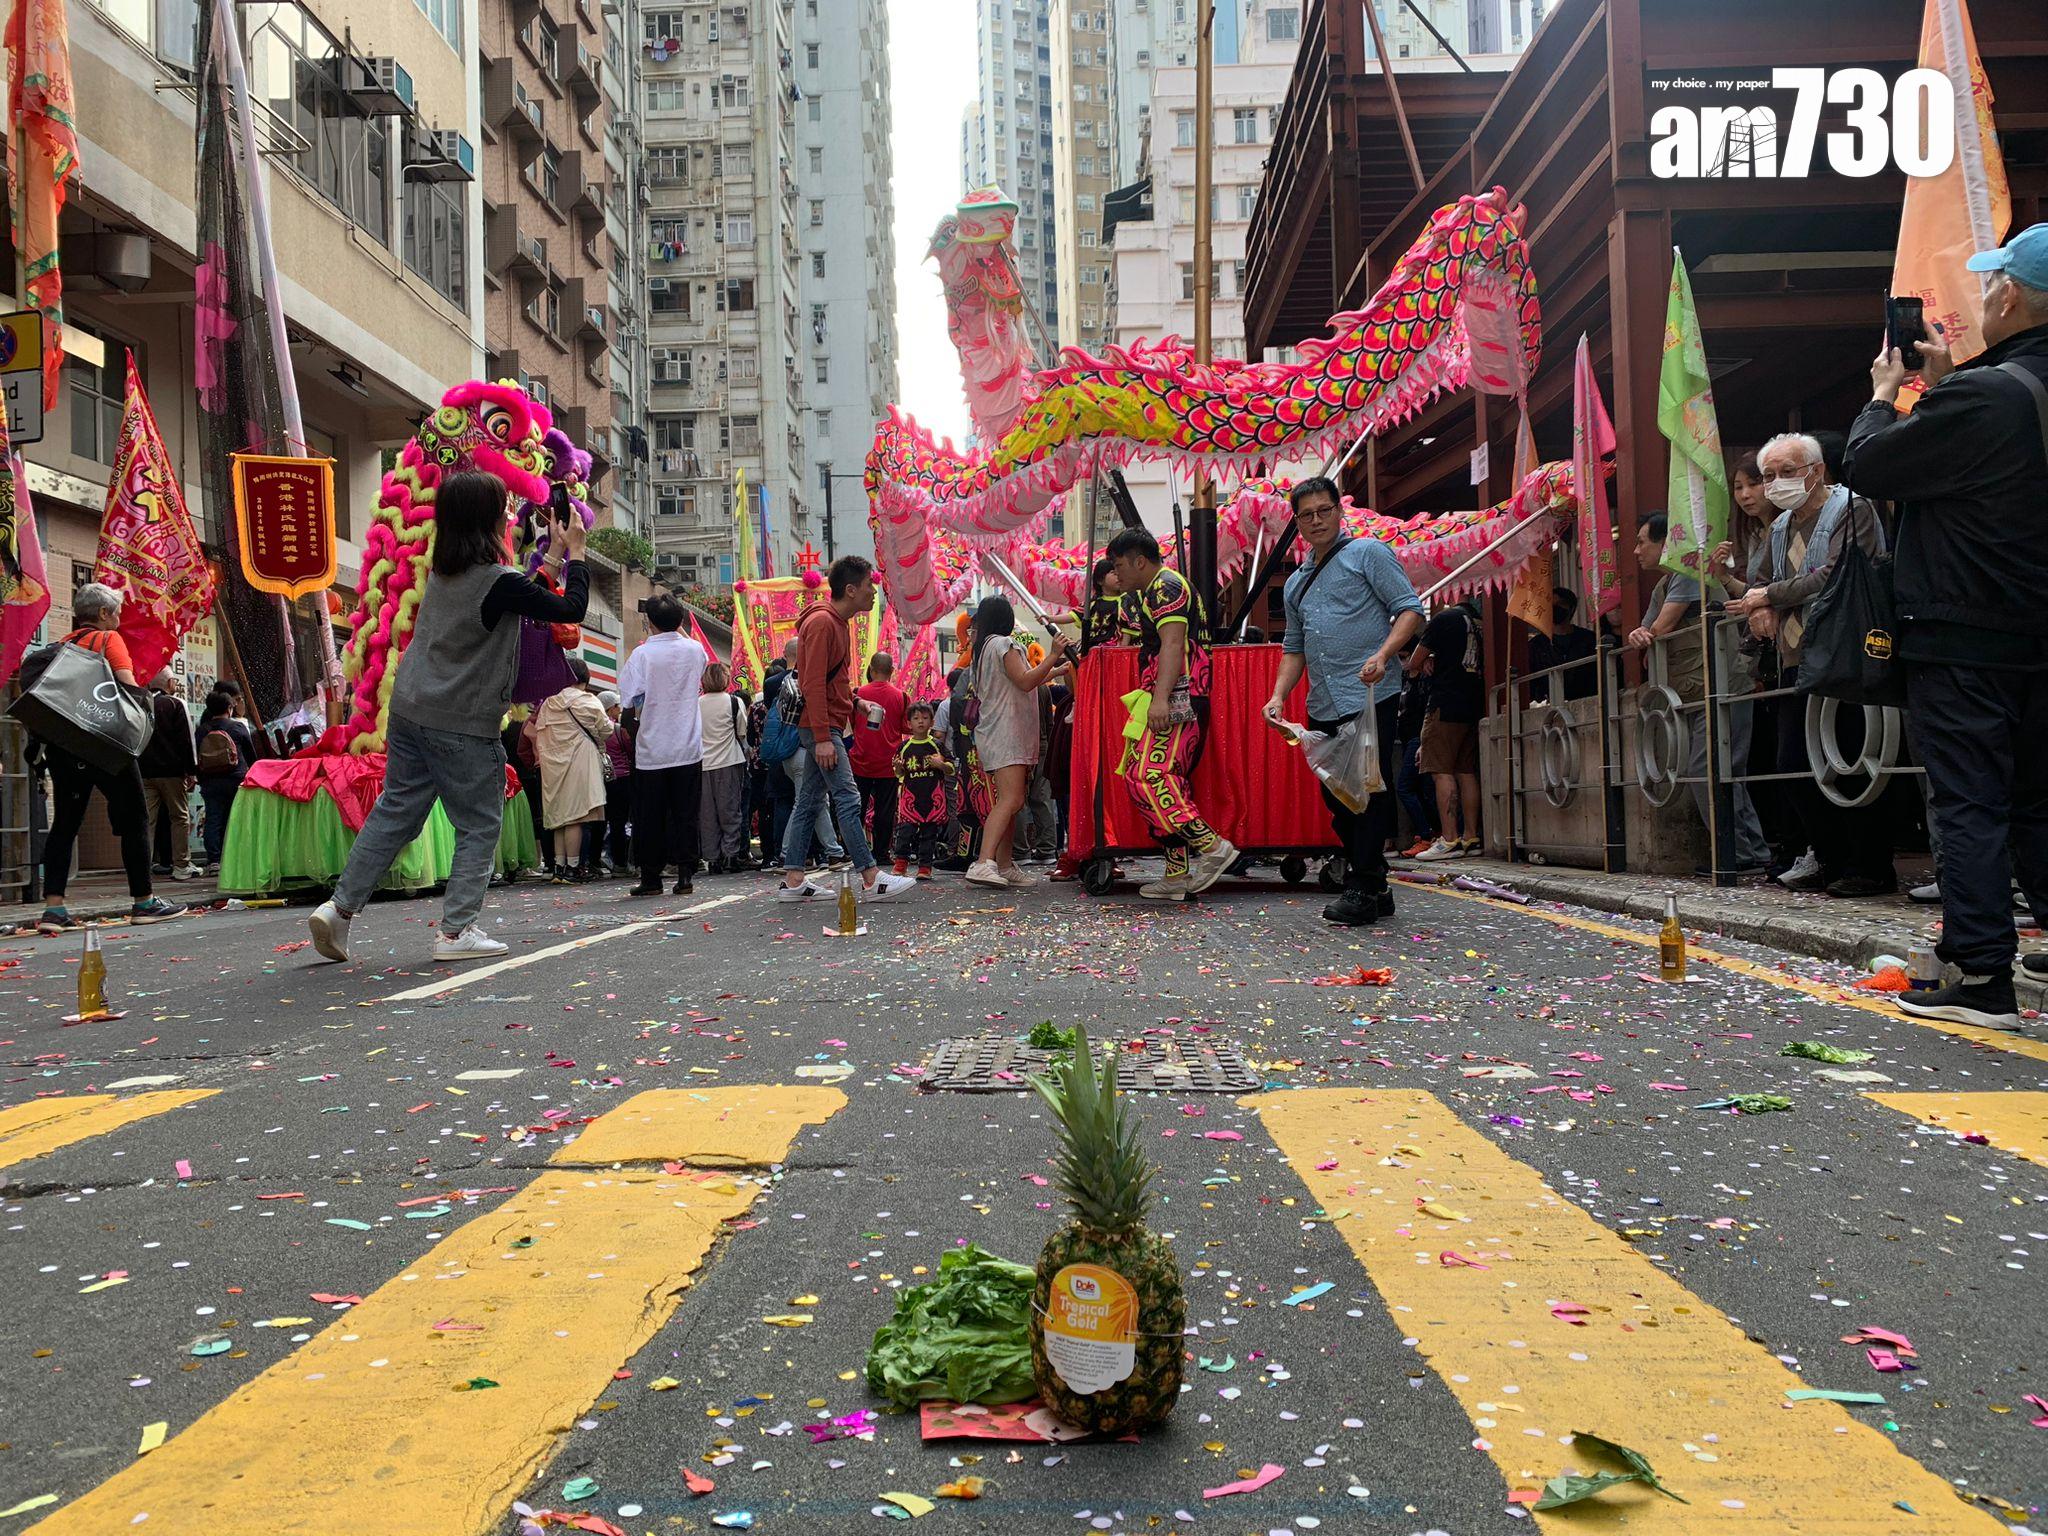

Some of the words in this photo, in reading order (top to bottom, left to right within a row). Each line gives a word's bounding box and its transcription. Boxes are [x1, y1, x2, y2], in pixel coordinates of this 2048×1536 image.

[107, 552, 146, 577] DRAGON
[78, 698, 115, 718] INDIGO
[1075, 1279, 1096, 1291] Dole
[1059, 1294, 1110, 1318] Tropical
[1066, 1312, 1099, 1331] Gold
